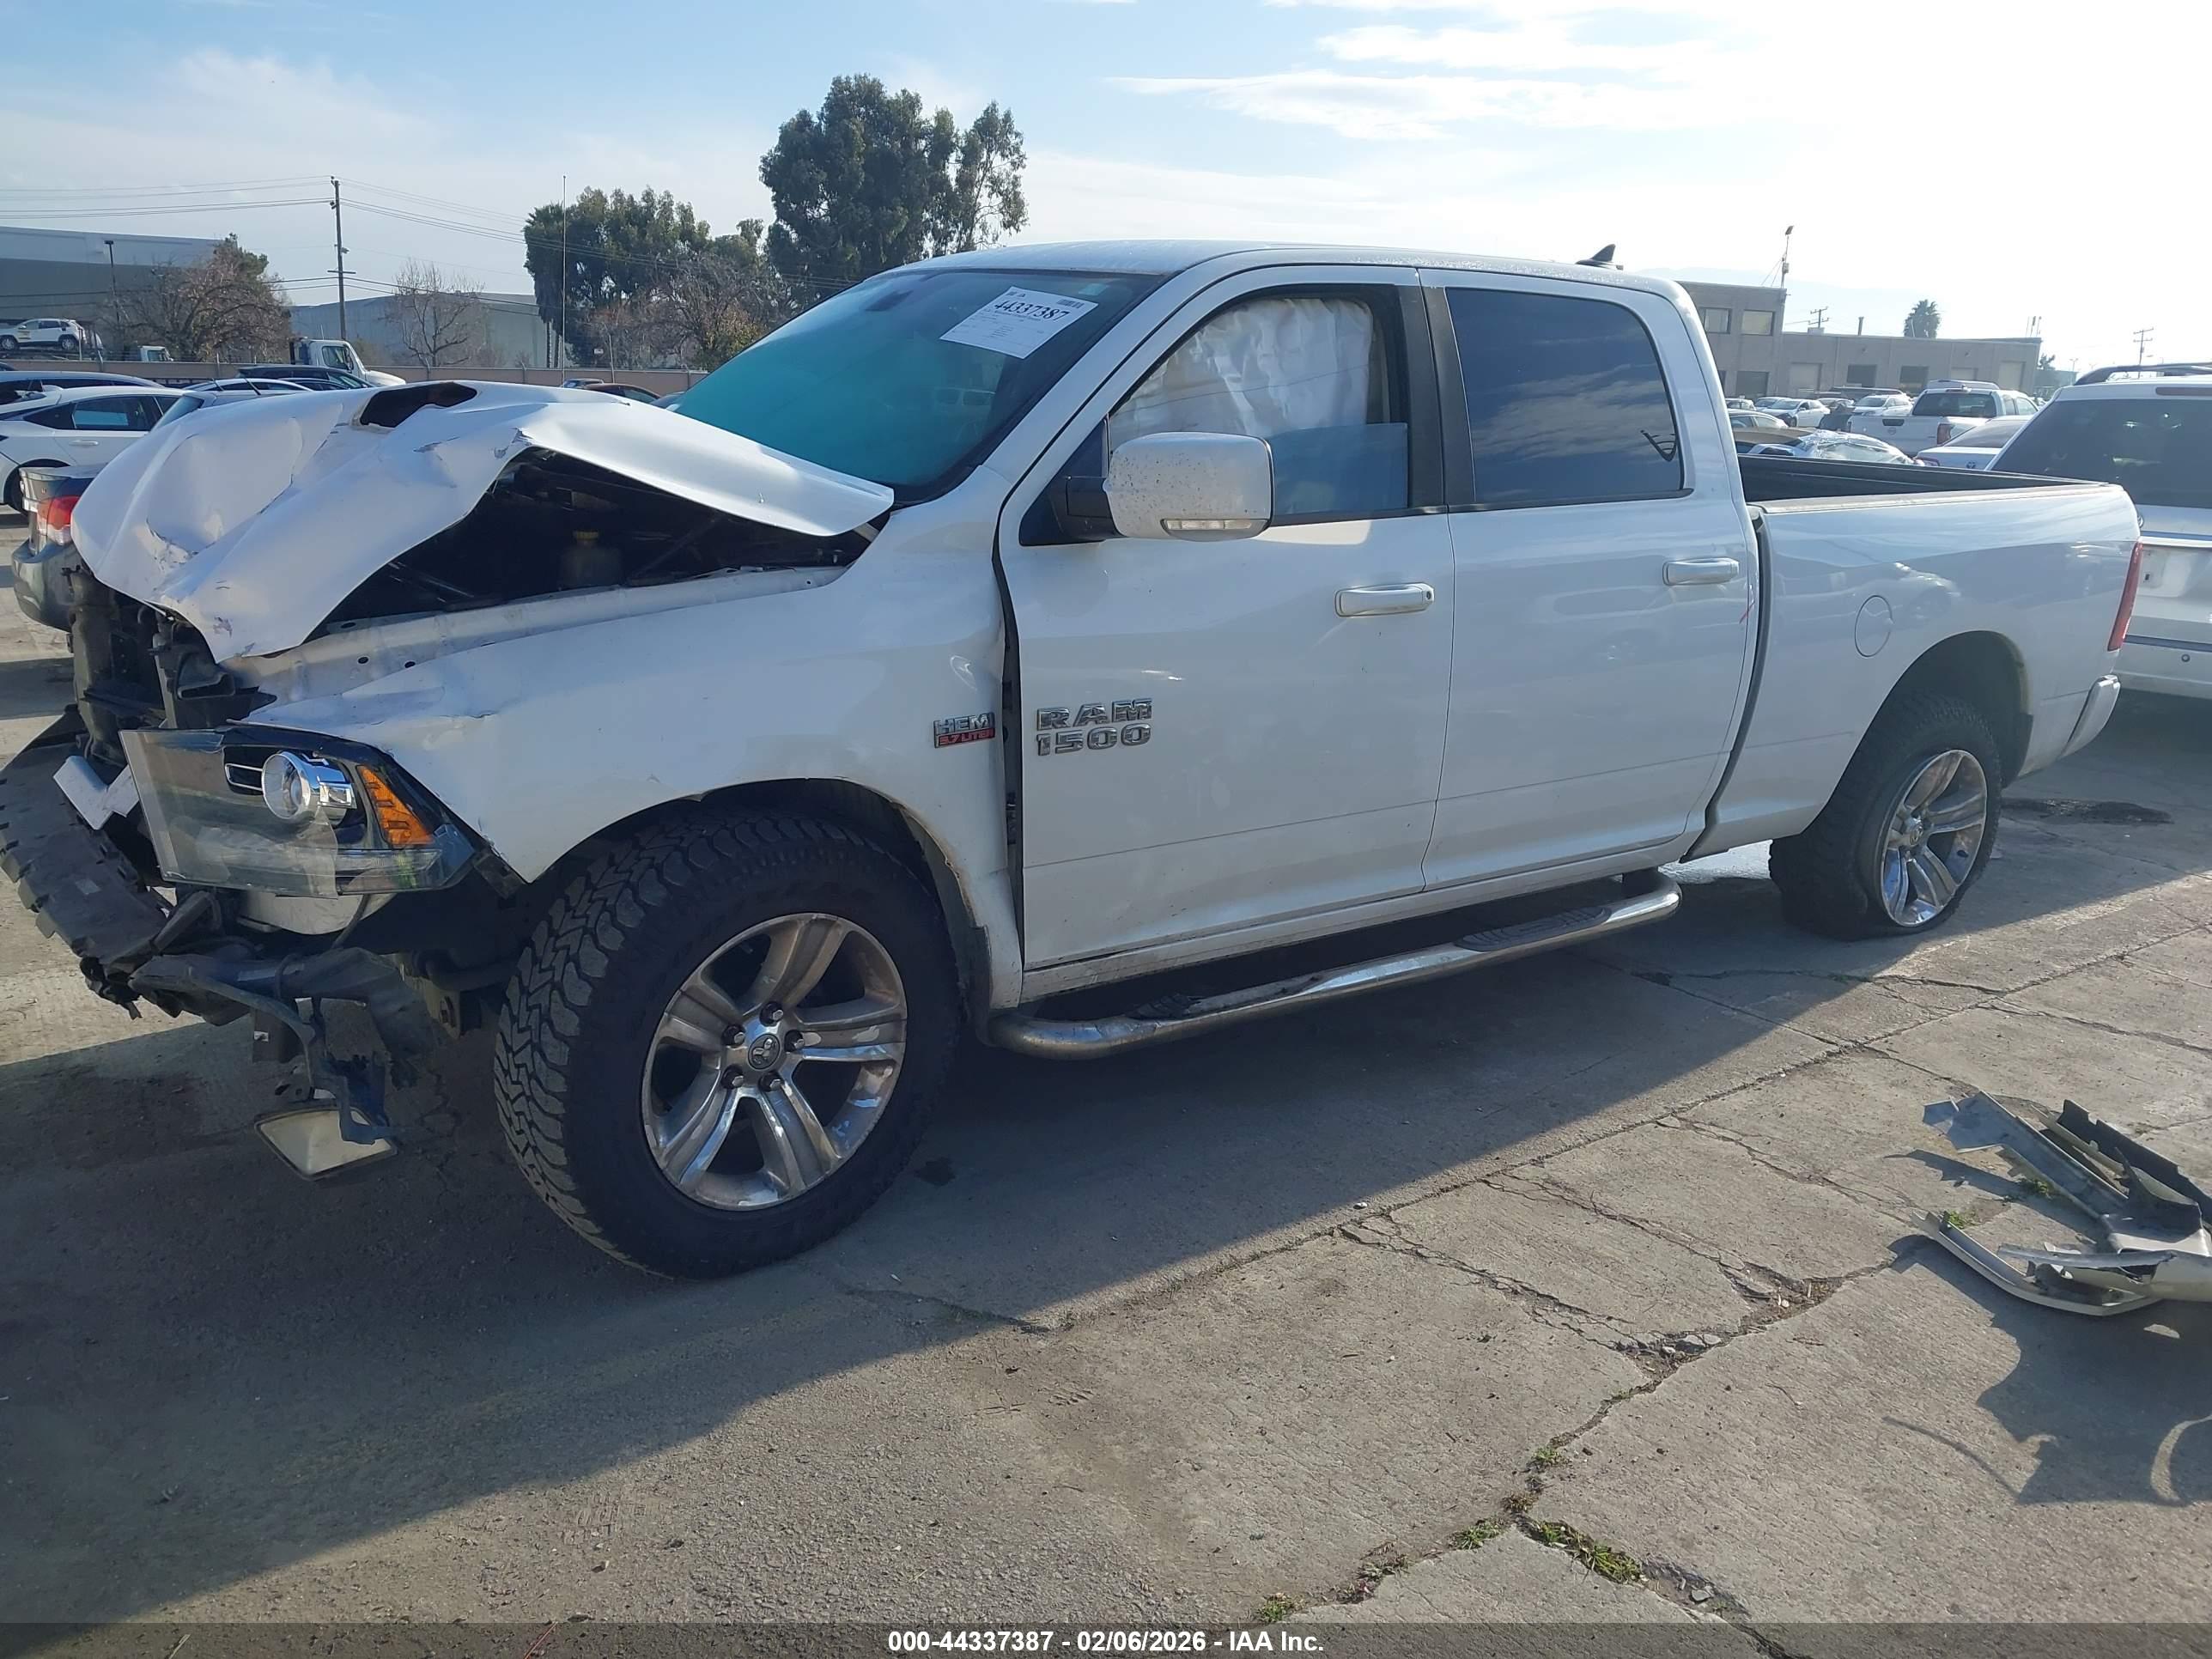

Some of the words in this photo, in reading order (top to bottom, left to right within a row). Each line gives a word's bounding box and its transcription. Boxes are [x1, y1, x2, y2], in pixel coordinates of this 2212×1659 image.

[994, 300, 1070, 321] 44337387
[1036, 697, 1152, 731] RAM
[1036, 723, 1152, 756] 1500
